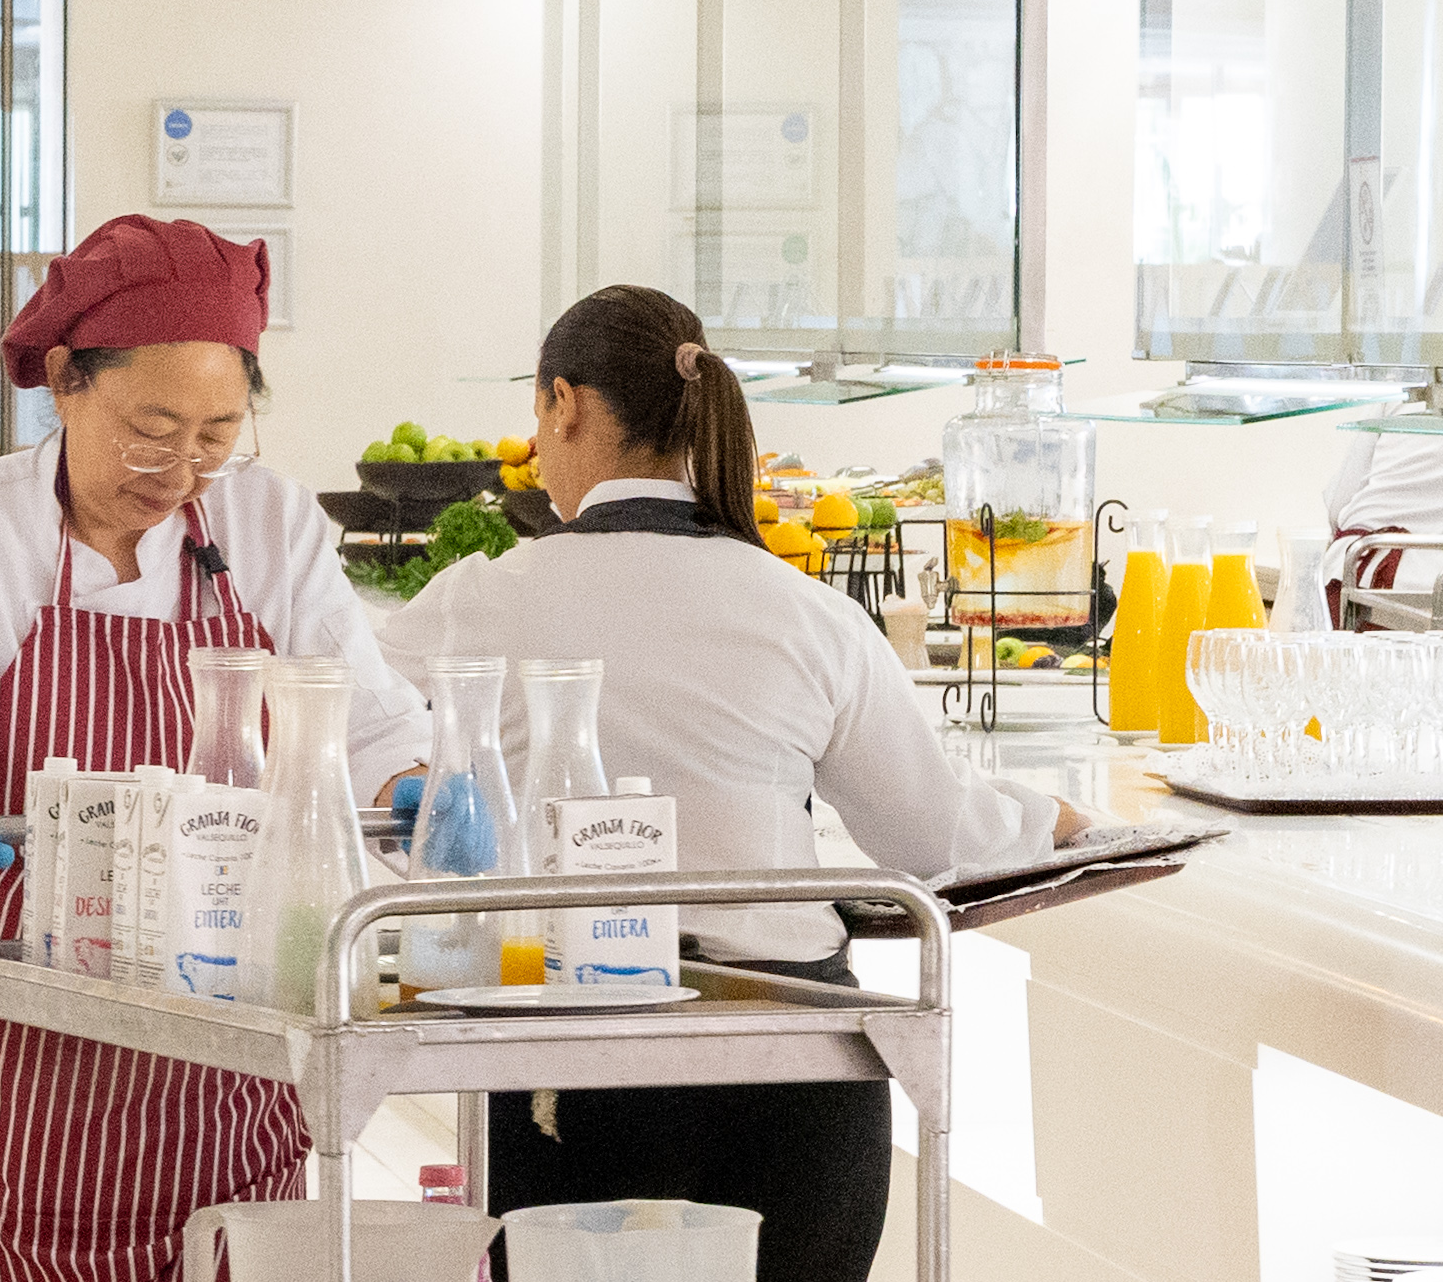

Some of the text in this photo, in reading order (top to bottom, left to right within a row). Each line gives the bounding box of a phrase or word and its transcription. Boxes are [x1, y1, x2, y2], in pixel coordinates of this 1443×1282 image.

[179, 810, 230, 838] GRANJA
[571, 817, 664, 848] GRANJA FLOR
[589, 839, 645, 850] VALSEQUILLO
[201, 882, 242, 896] LECHE
[592, 917, 650, 939] ENTERA
